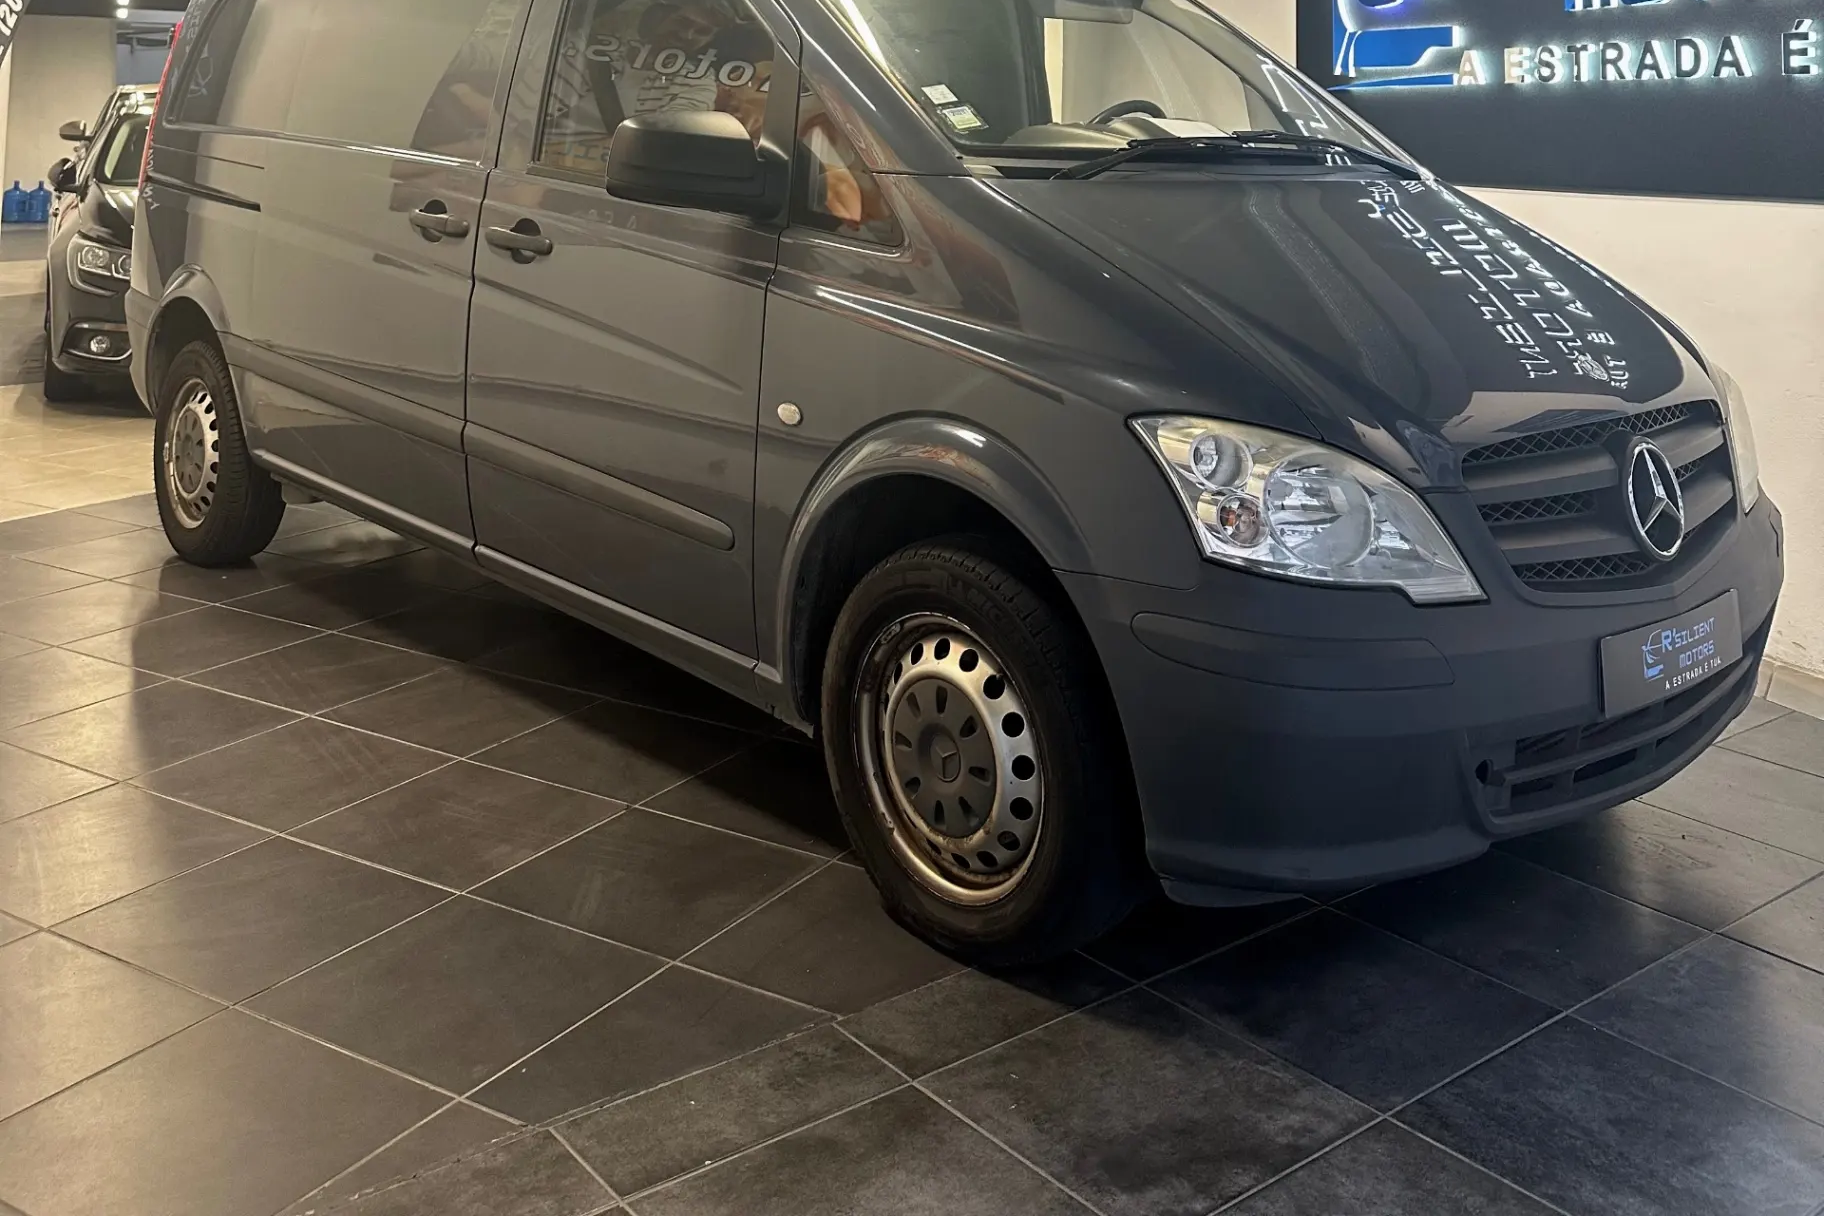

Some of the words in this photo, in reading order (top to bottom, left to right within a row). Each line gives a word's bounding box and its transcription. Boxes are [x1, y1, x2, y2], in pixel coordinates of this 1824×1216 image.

[1454, 49, 1487, 85] A
[1503, 35, 1754, 85] ESTRADA
[1780, 19, 1820, 77] É
[1661, 616, 1715, 653] R'SILIENT
[1679, 640, 1715, 669] MOTORS
[1665, 680, 1670, 690] A
[1673, 666, 1703, 687] ESTRADA
[1710, 656, 1722, 669] TUA
